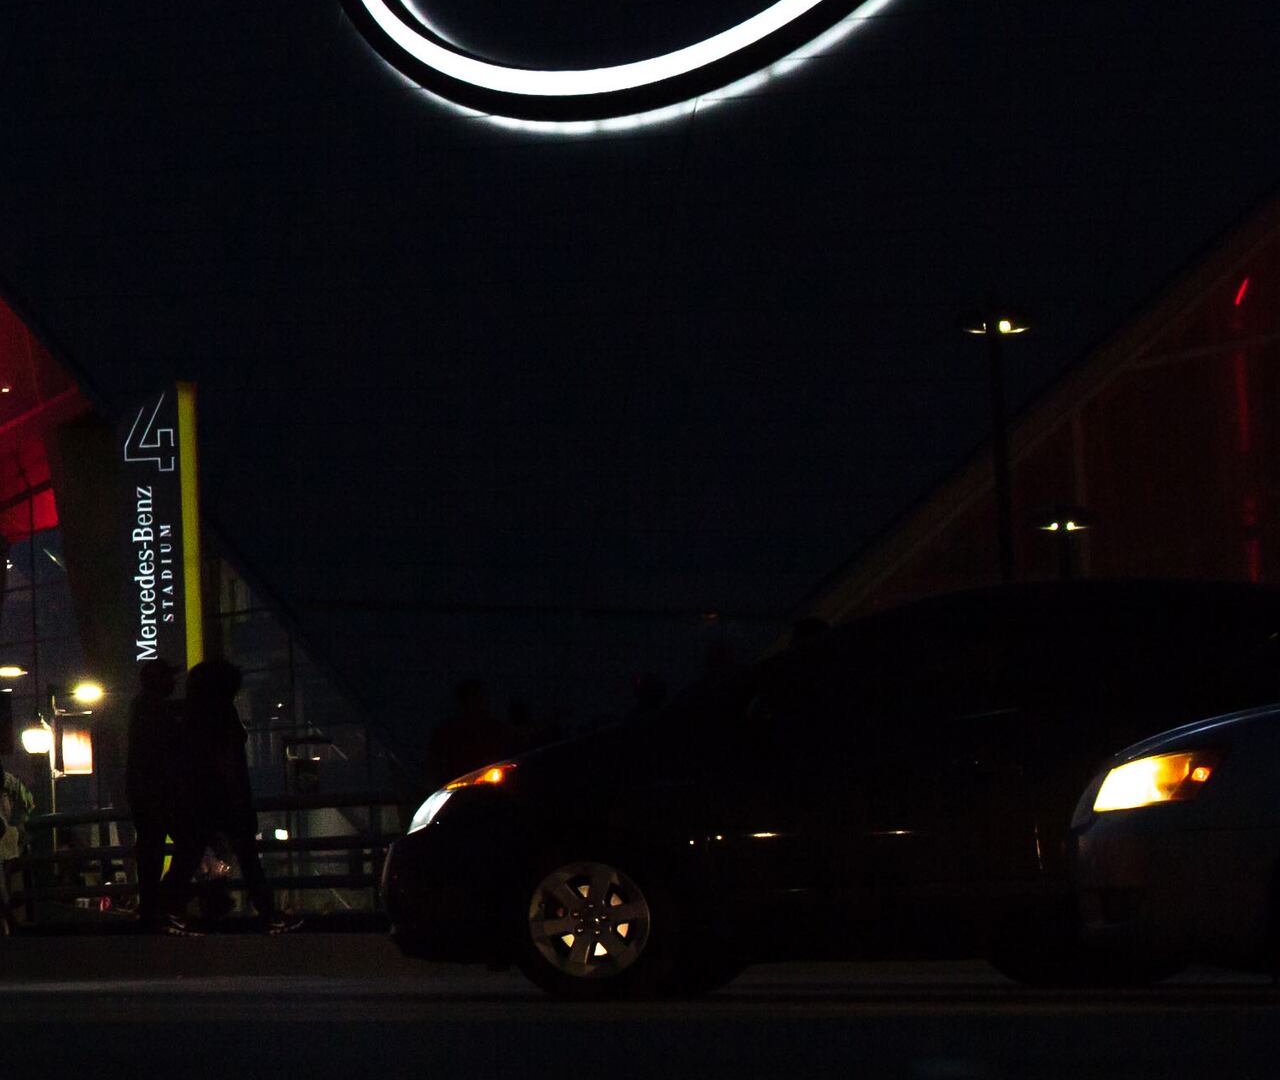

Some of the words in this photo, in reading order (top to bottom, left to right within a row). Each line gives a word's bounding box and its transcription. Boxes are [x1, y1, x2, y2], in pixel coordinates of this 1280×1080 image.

[124, 393, 175, 472] 4
[131, 485, 158, 662] Mercedes-Benz
[159, 524, 175, 623] STADIUM
